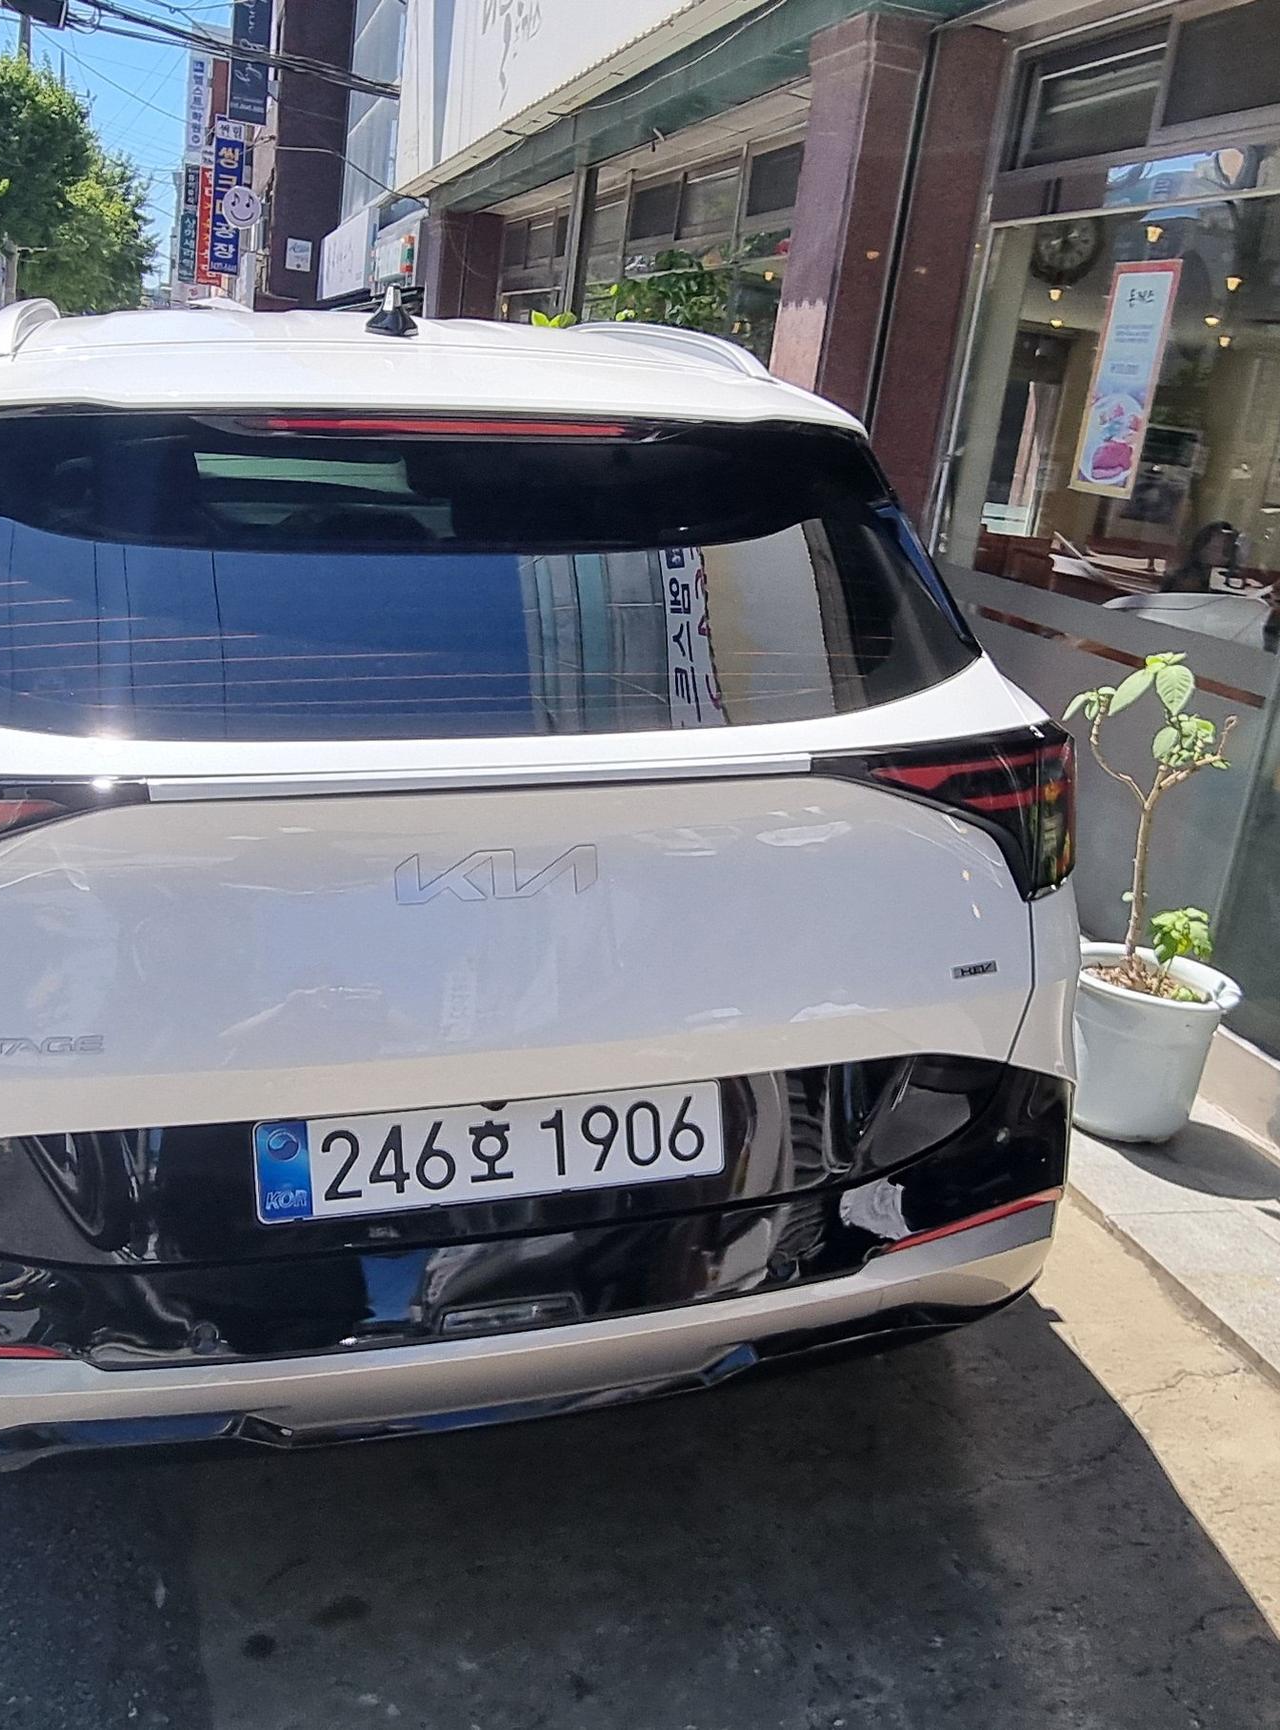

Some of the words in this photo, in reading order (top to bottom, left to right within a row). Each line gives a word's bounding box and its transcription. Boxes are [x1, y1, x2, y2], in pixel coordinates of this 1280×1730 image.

[394, 843, 599, 906] KIA
[320, 1118, 514, 1202] 246호
[540, 1095, 705, 1177] 1906
[264, 1188, 308, 1212] KOR
